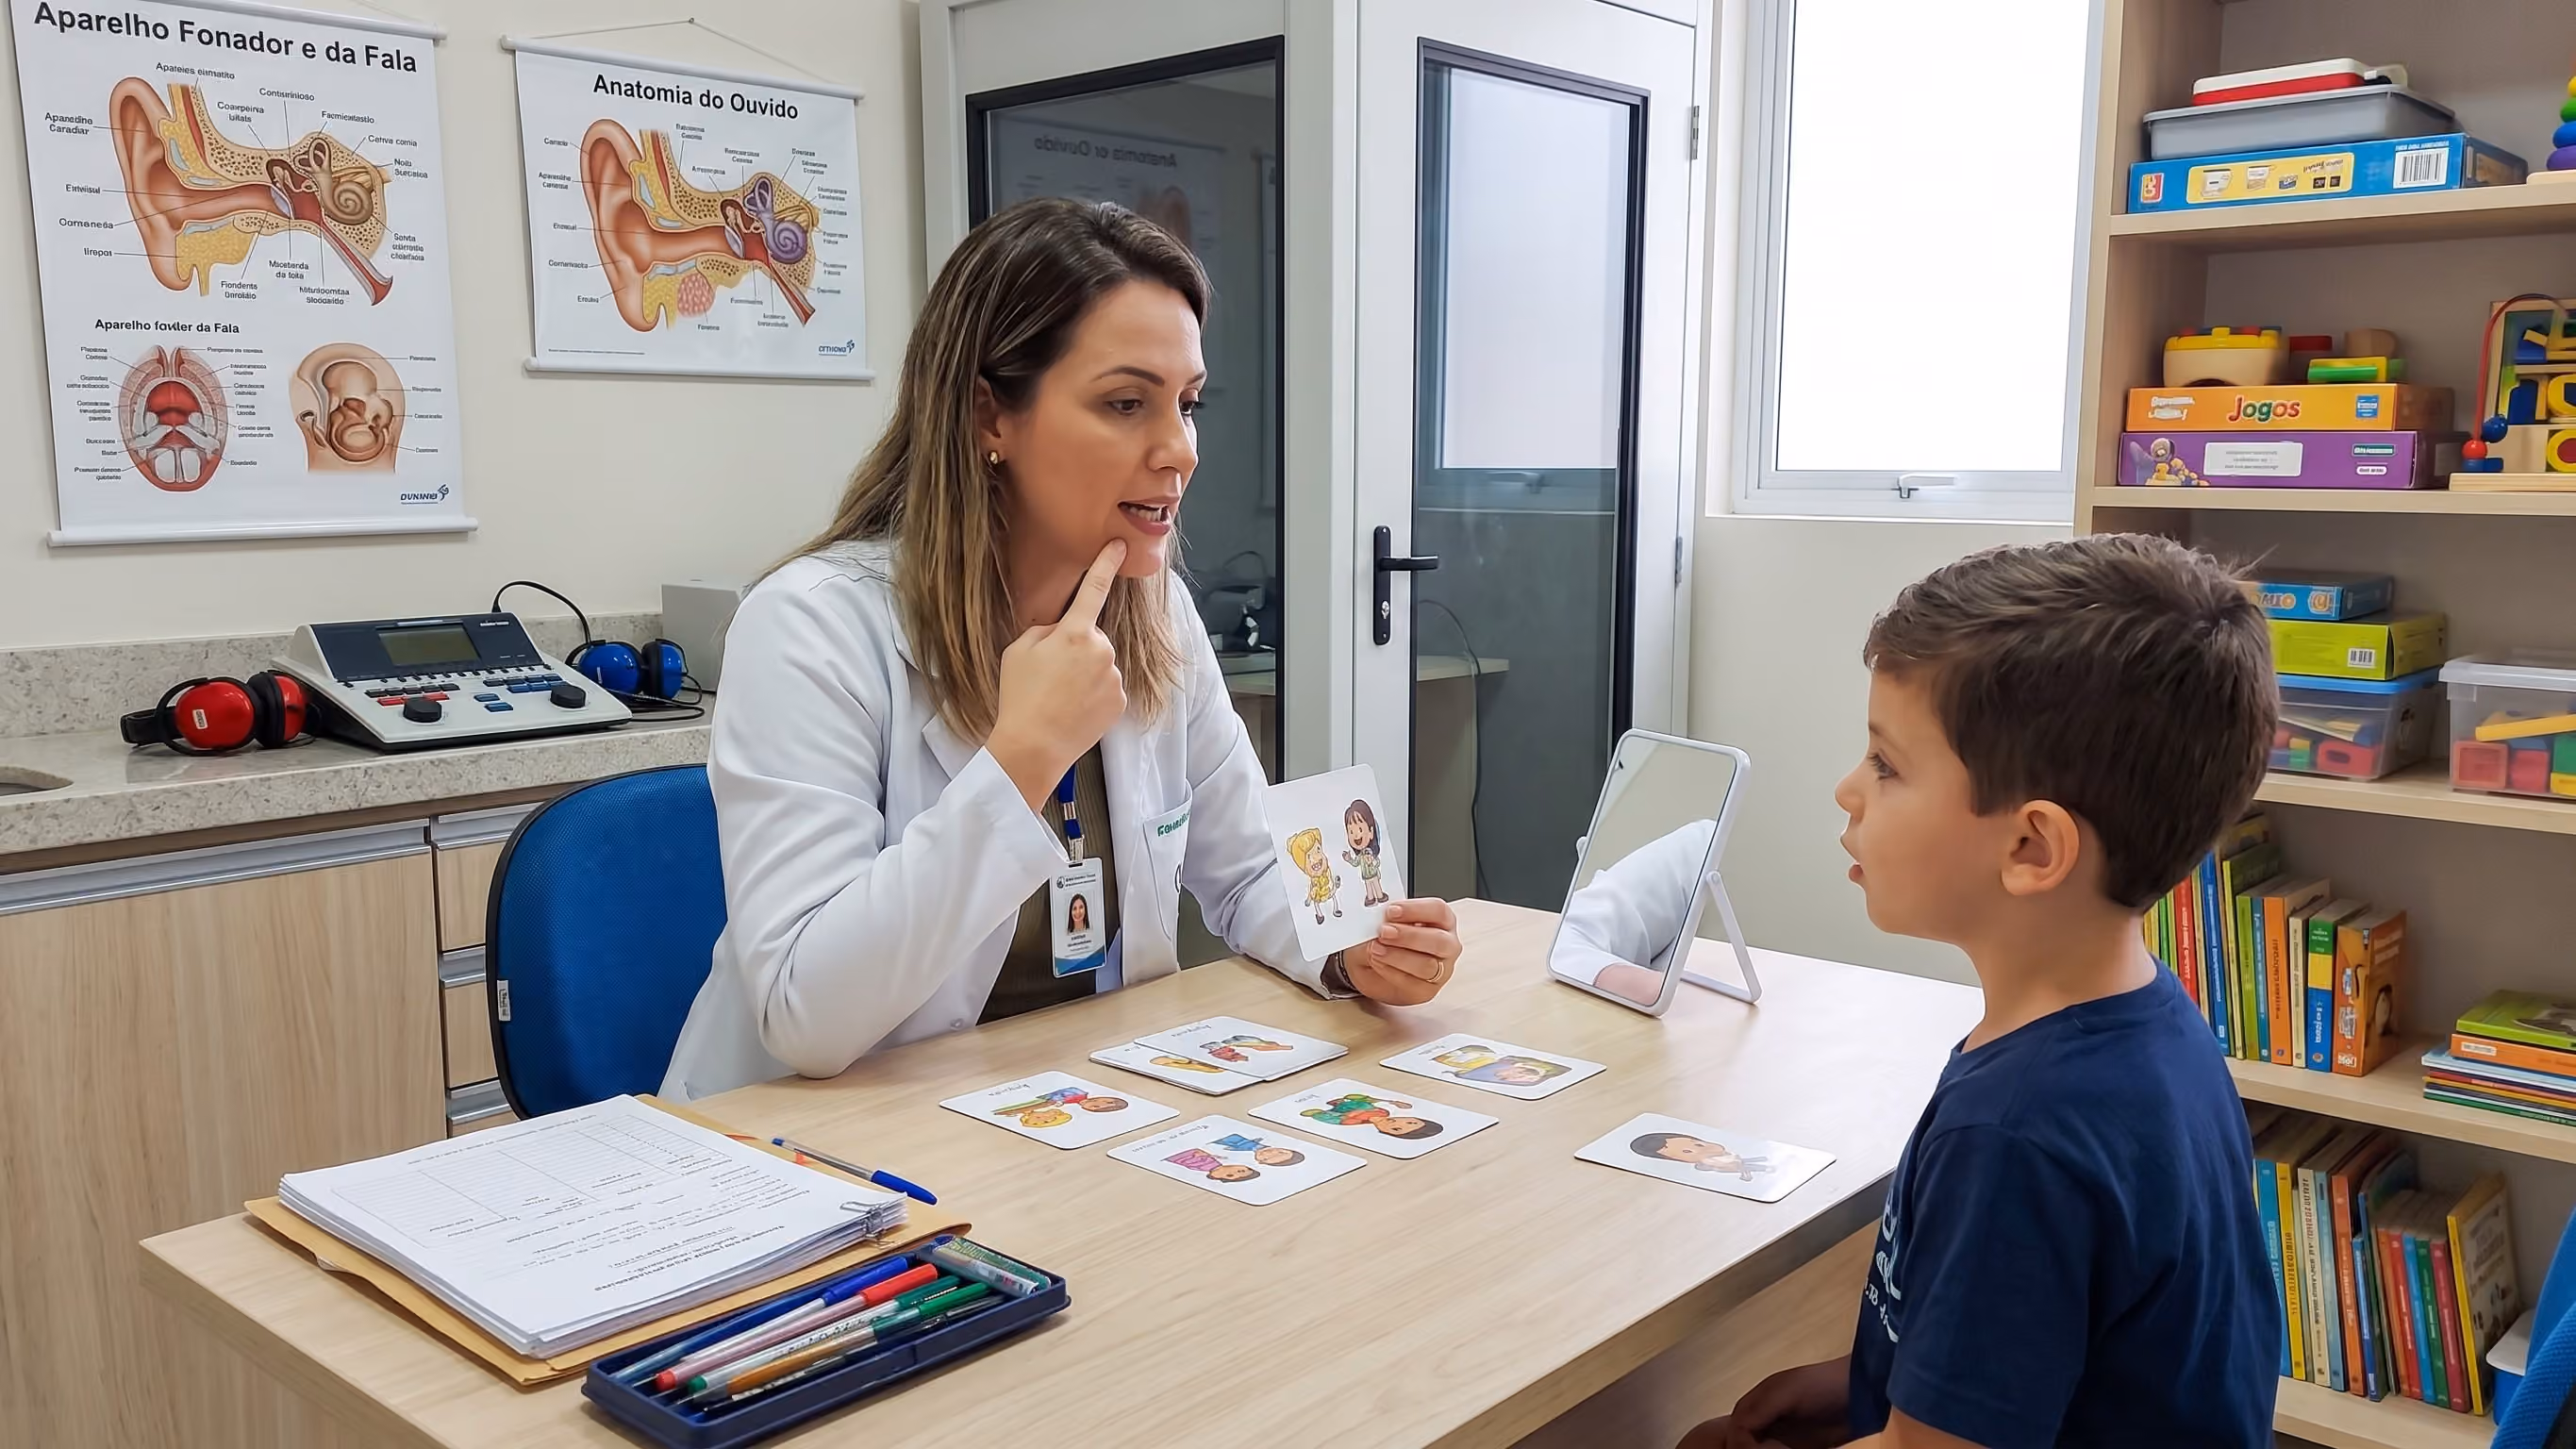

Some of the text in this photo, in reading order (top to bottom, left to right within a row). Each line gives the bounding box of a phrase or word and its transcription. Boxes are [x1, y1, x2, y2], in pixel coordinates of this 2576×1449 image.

[34, 2, 416, 73] Aparelho Fonador e da Fala
[593, 75, 798, 119] Anatomia do Ouvido
[95, 319, 151, 331] Aparelho
[196, 323, 210, 332] da
[214, 324, 240, 333] Fala
[2227, 395, 2302, 423] Jogos
